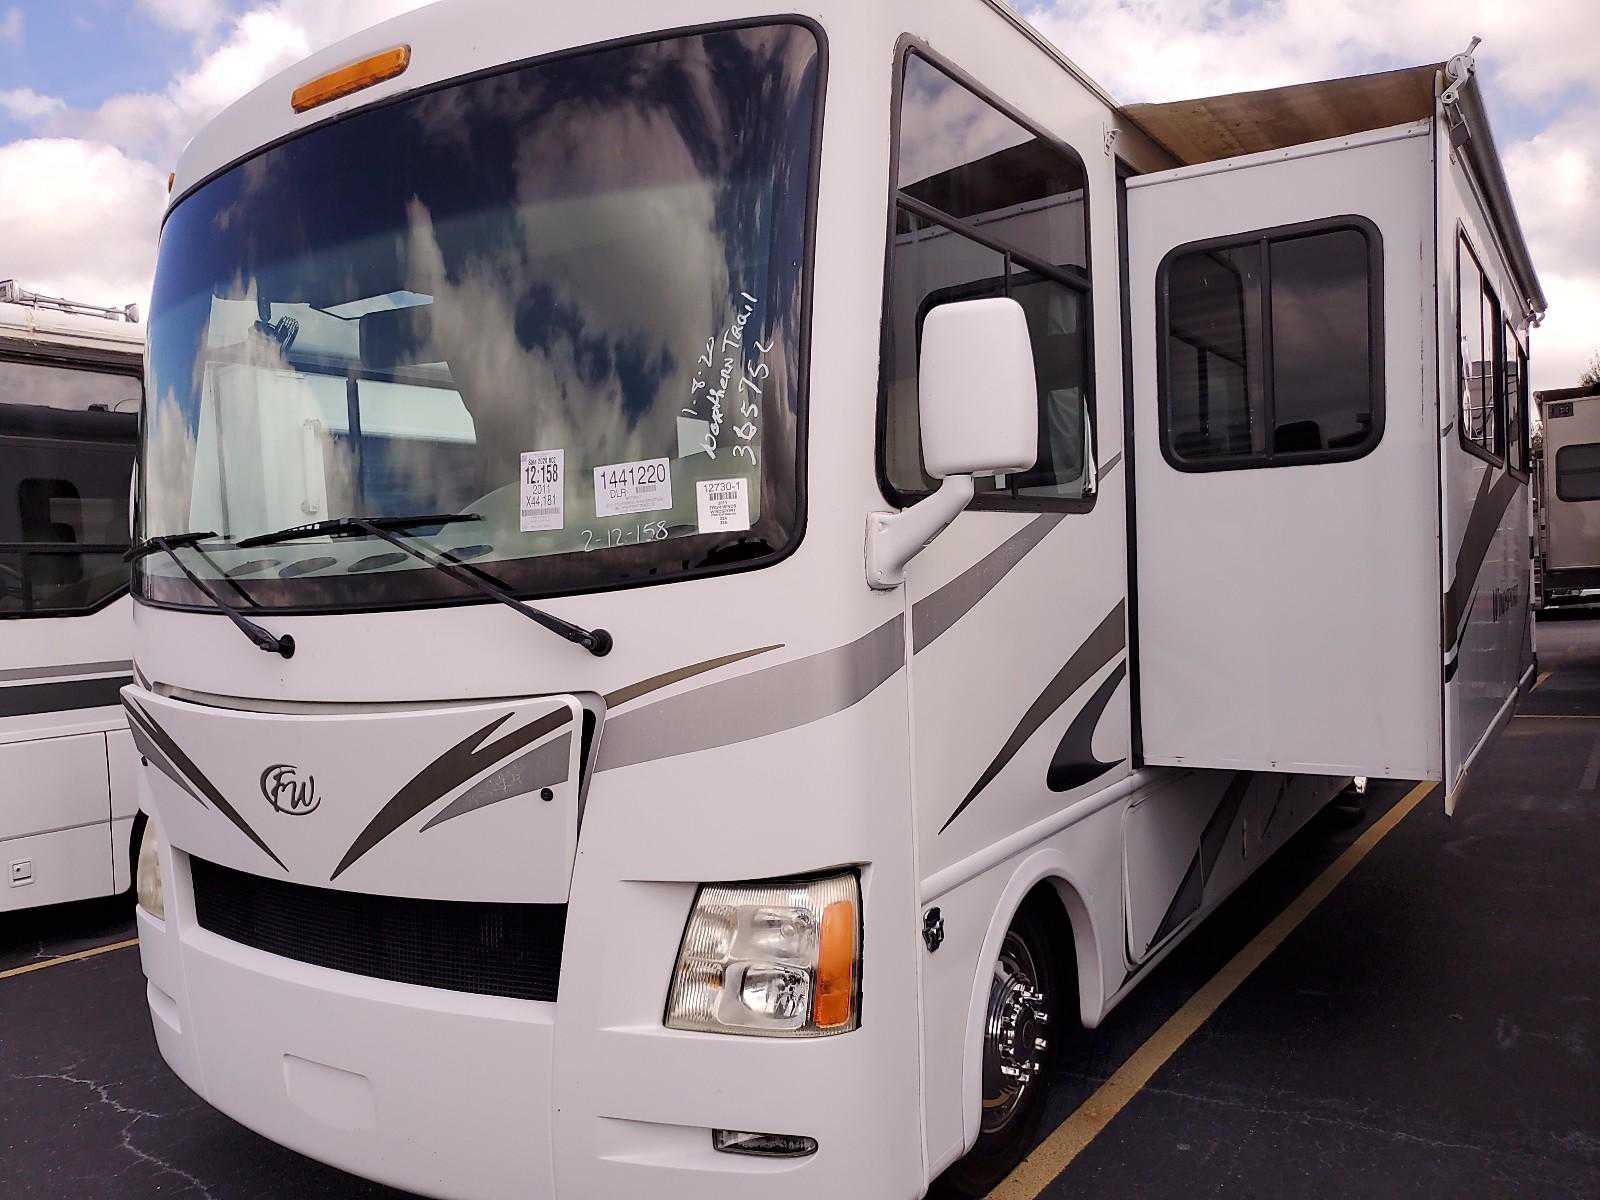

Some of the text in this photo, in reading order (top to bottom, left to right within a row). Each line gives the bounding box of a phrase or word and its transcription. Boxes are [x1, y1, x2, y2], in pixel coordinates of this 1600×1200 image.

[525, 463, 558, 485] 12:158
[601, 463, 666, 490] 1441220
[533, 484, 550, 495] 2011
[703, 481, 741, 493] 12730-1
[580, 520, 669, 552] 2-12-158
